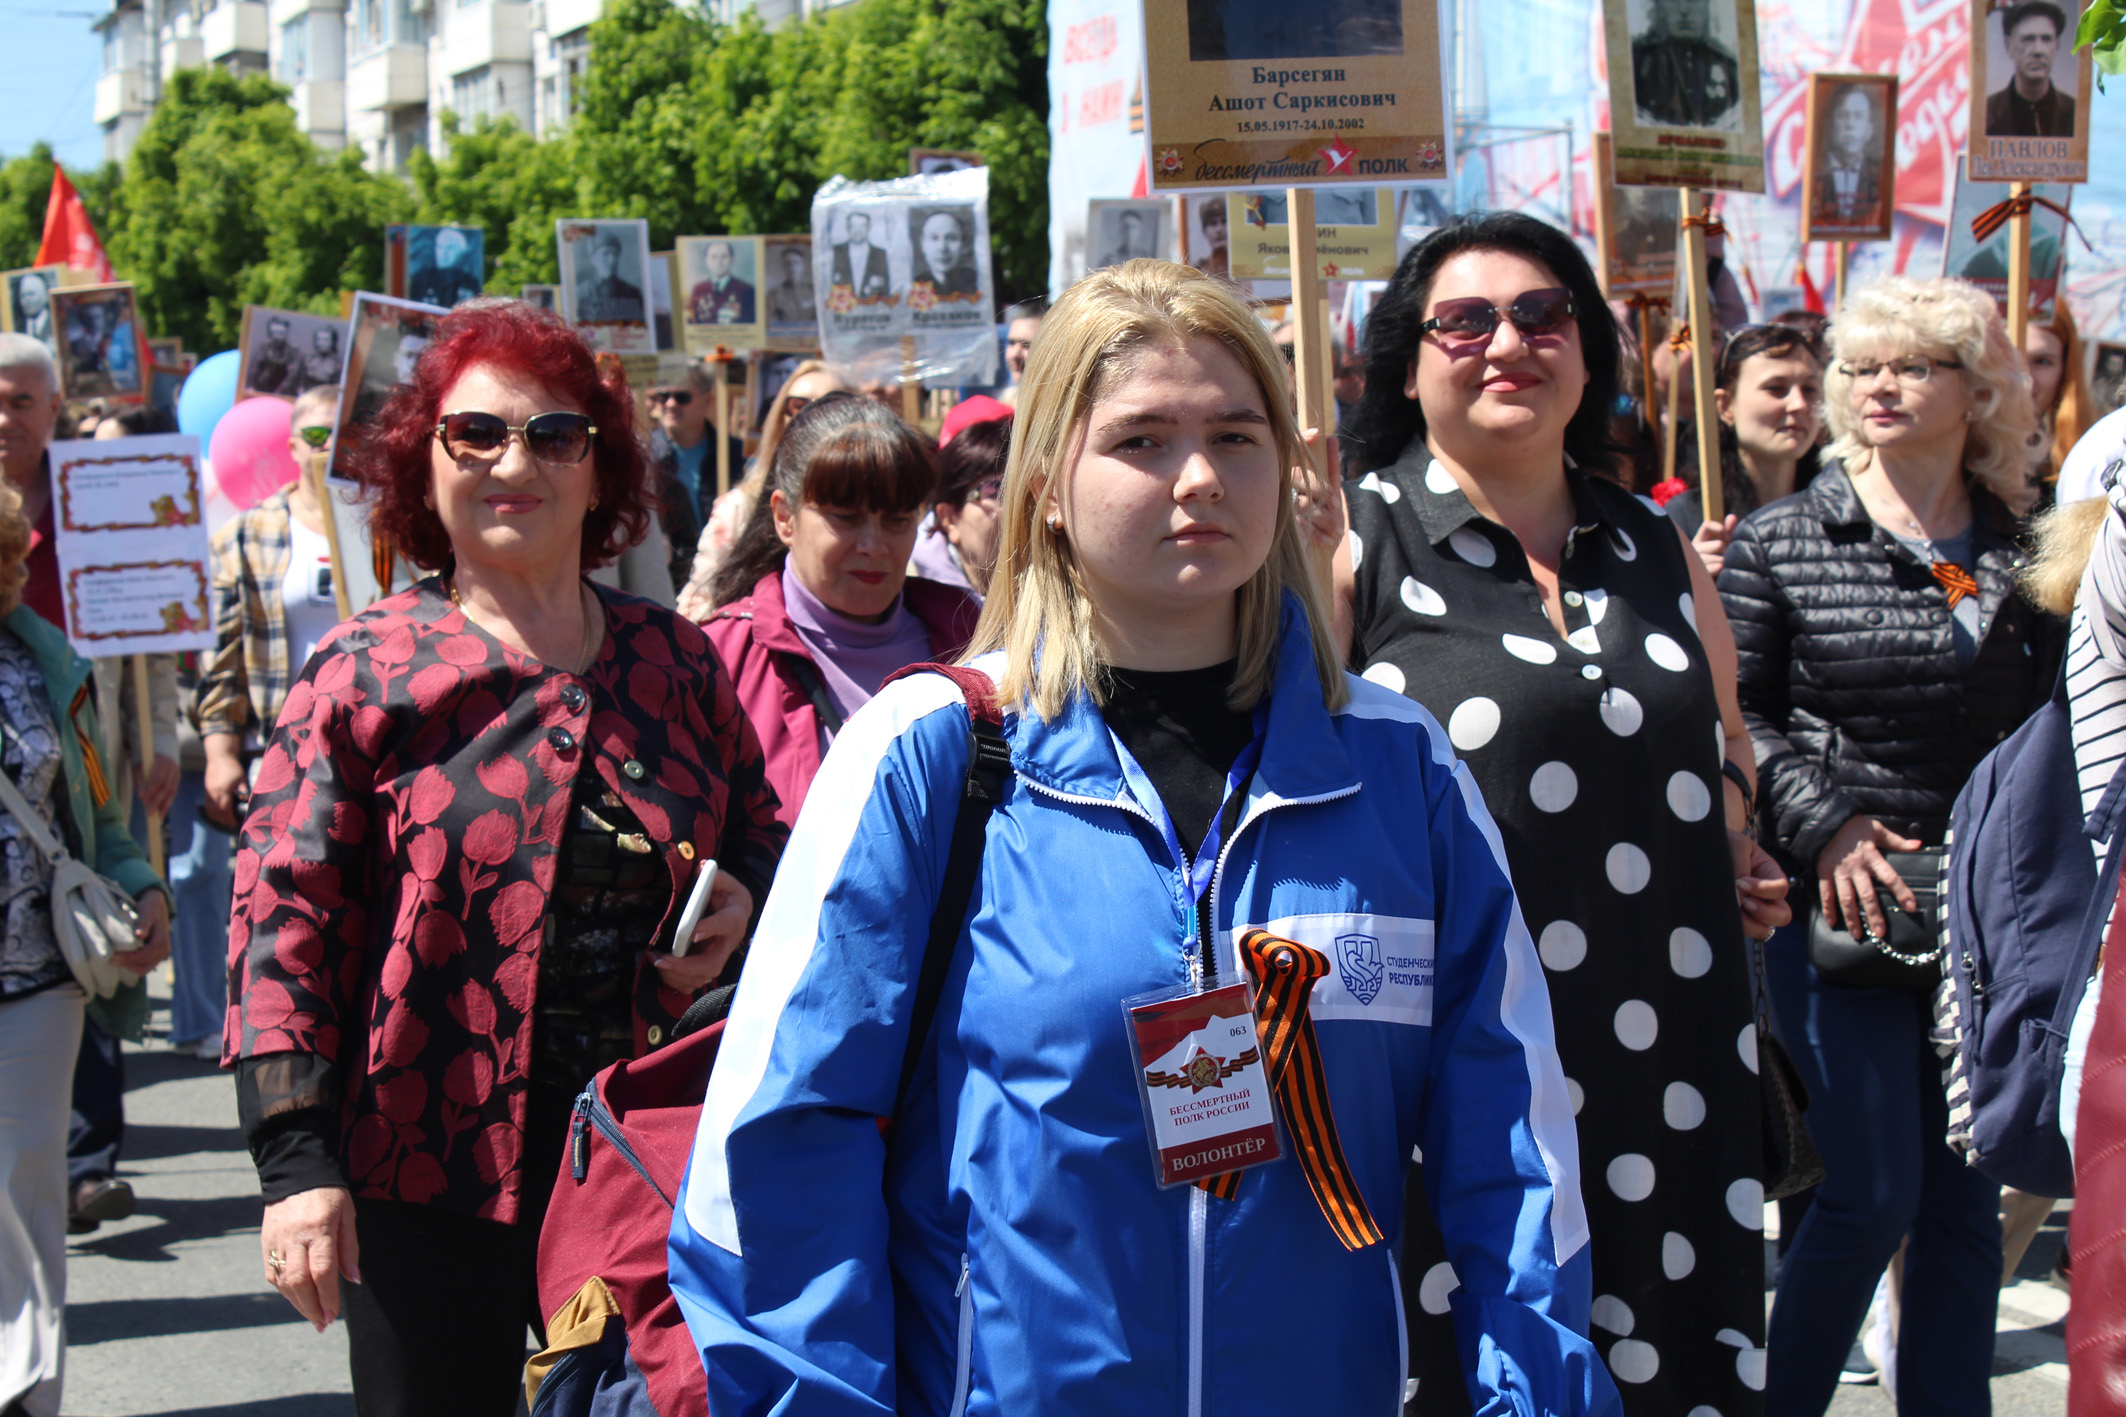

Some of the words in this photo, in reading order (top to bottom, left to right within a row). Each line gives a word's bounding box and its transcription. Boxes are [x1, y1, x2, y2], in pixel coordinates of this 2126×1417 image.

[1252, 65, 1346, 88] Барсегян
[1208, 94, 1267, 112] Ашот
[1273, 92, 1397, 113] Саркисович
[1237, 118, 1365, 133] 15.05.1917-24.10.2002
[1990, 140, 2068, 158] ПАВЛОВ
[1194, 138, 1321, 184] бессмертный
[1230, 1026, 1247, 1037] 063
[1169, 1088, 1251, 1116] БЕССМЕРТНЫЙ
[1174, 1113, 1205, 1126] ПОЛК
[1206, 1101, 1250, 1119] РОССИИ
[1172, 1138, 1266, 1171] ВОЛОНТЁР
